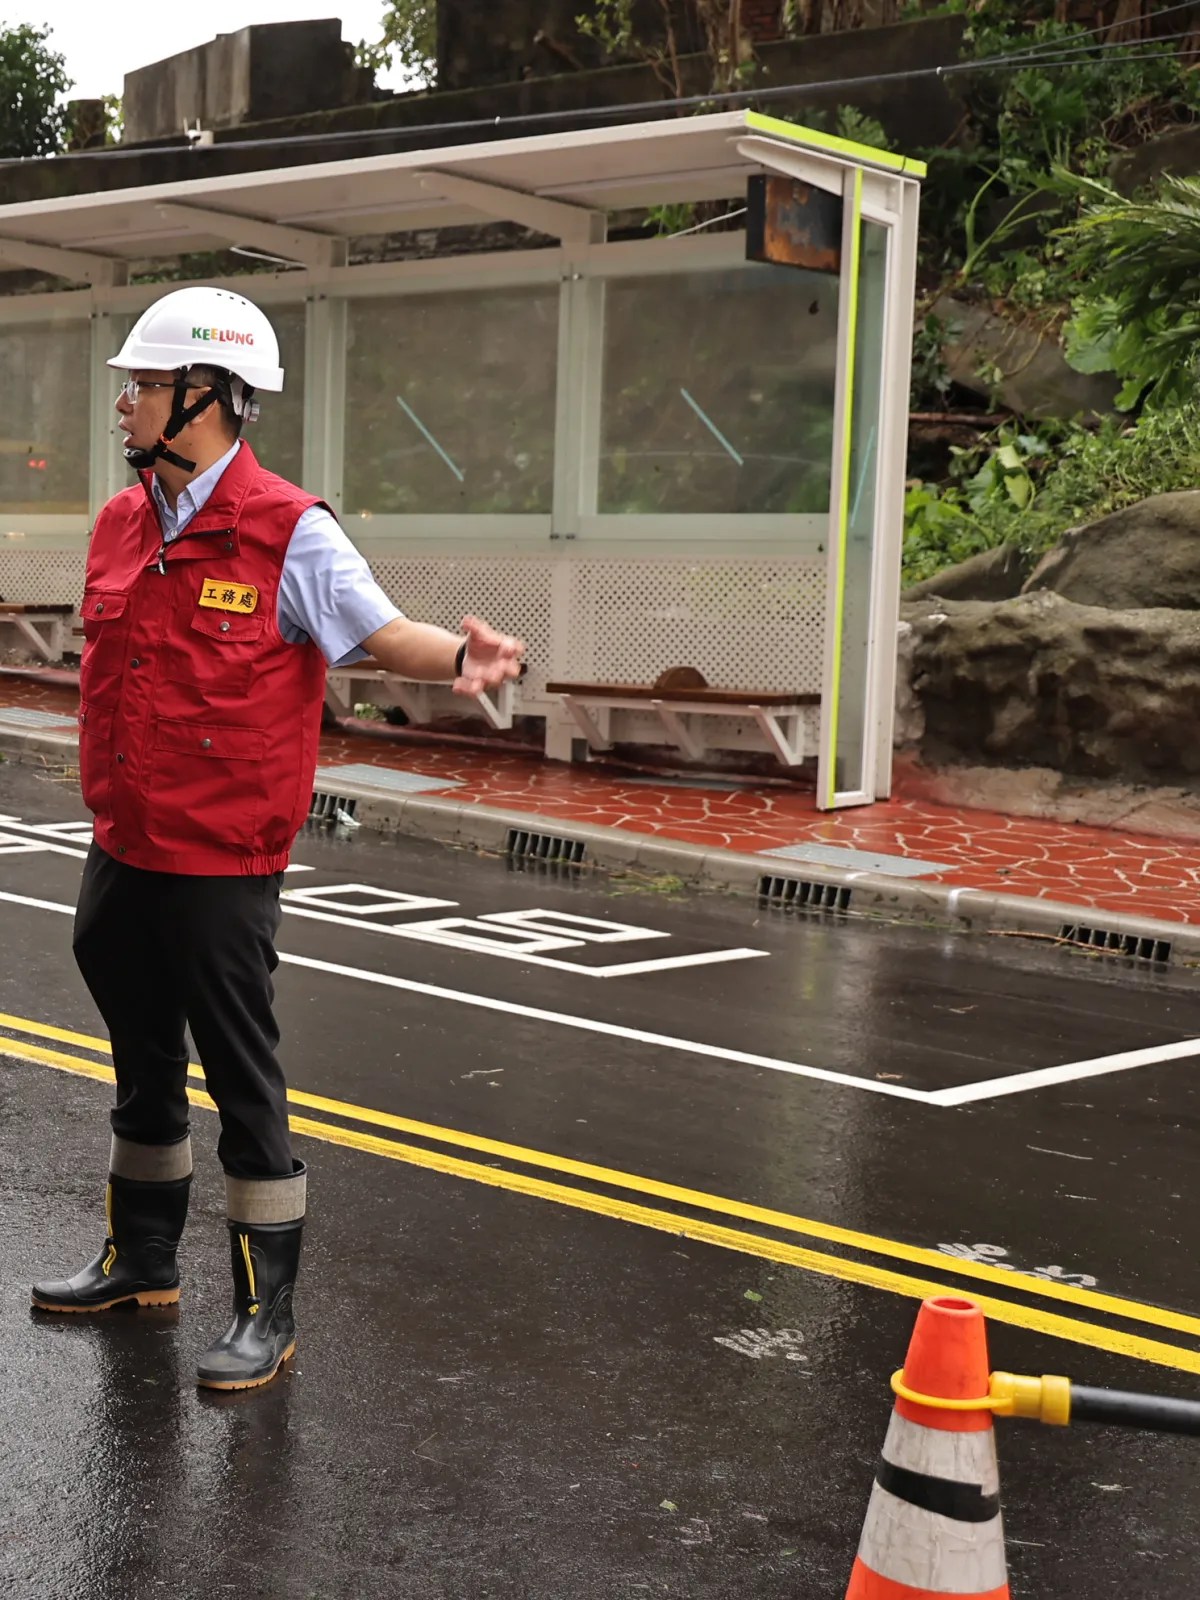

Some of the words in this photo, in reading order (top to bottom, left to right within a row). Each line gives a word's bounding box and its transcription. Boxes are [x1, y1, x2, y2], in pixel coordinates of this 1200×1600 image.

[192, 328, 254, 345] KEELUNG
[203, 588, 254, 607] 工務處
